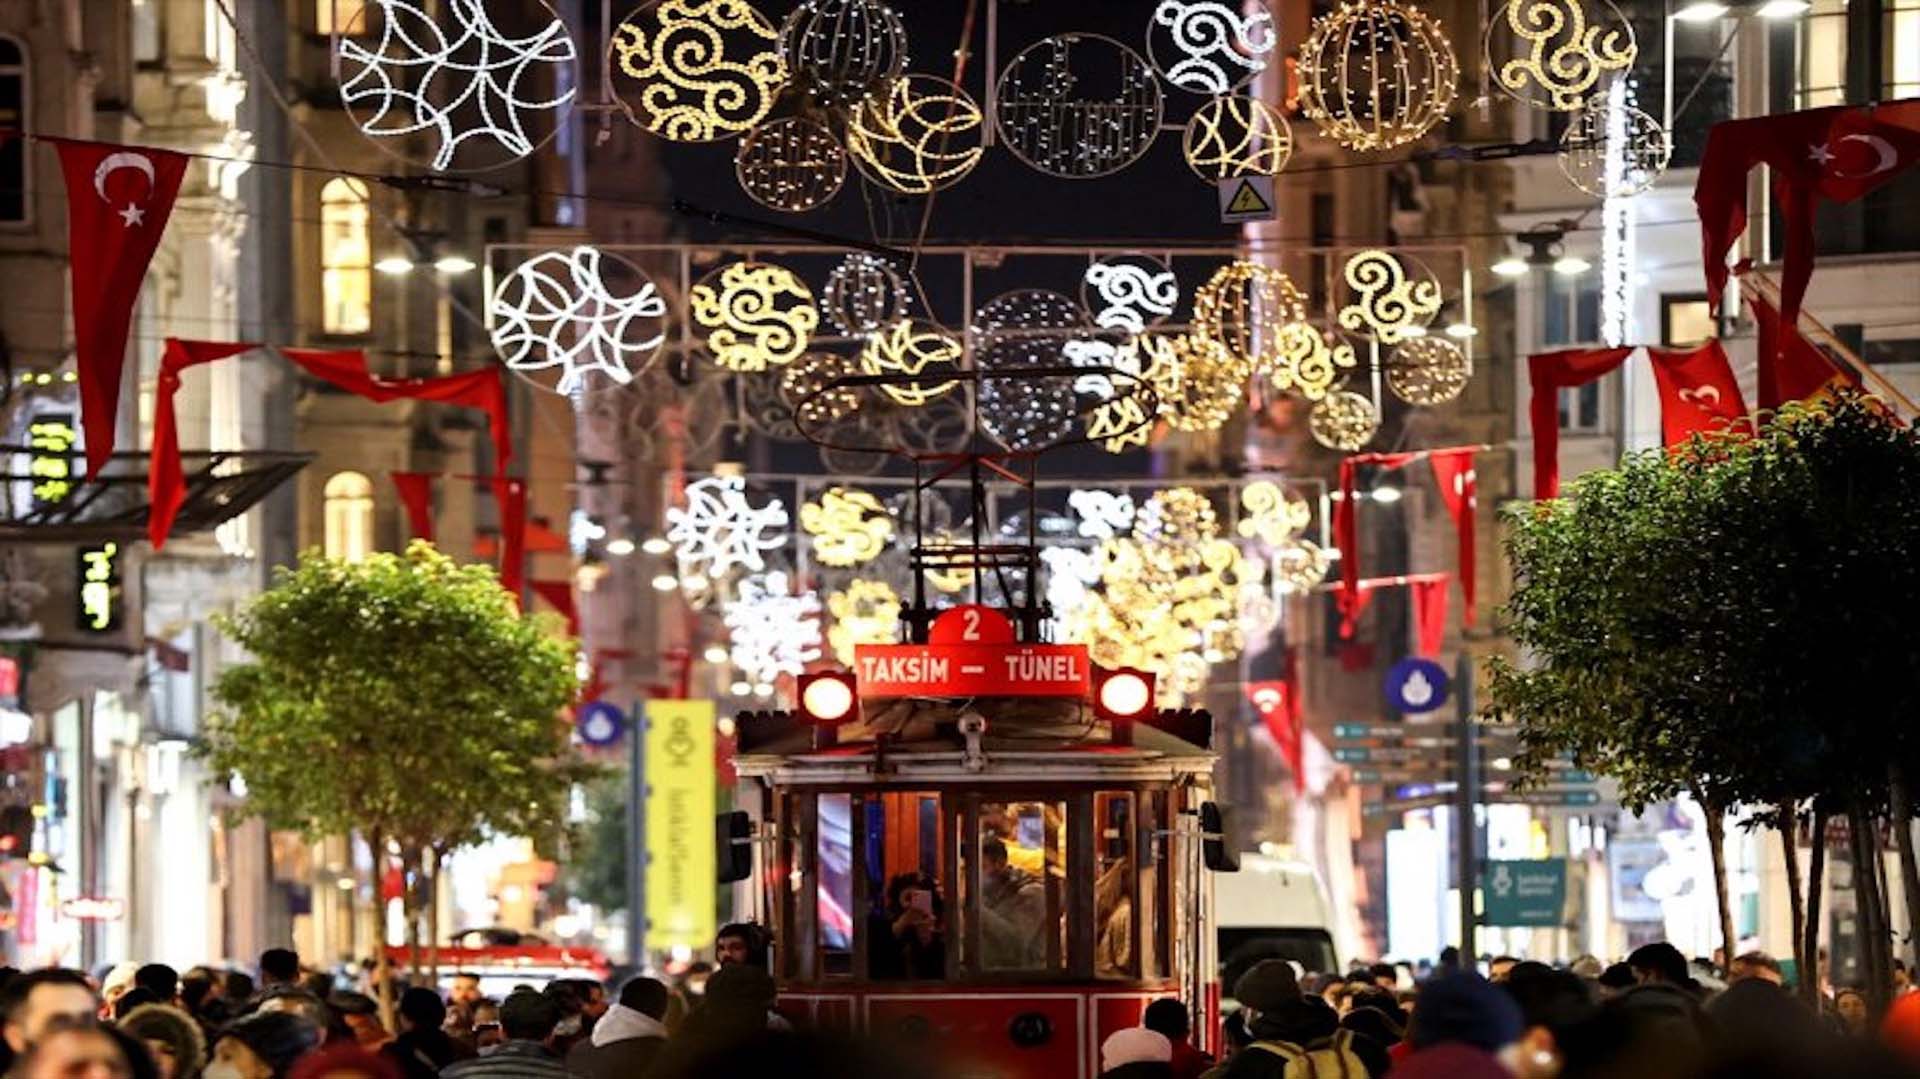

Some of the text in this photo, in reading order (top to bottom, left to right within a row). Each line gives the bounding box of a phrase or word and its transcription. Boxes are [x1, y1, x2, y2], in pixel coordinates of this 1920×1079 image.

[963, 610, 981, 642] 2
[862, 651, 949, 684] TAKSİM
[1005, 648, 1082, 682] TÜNEL
